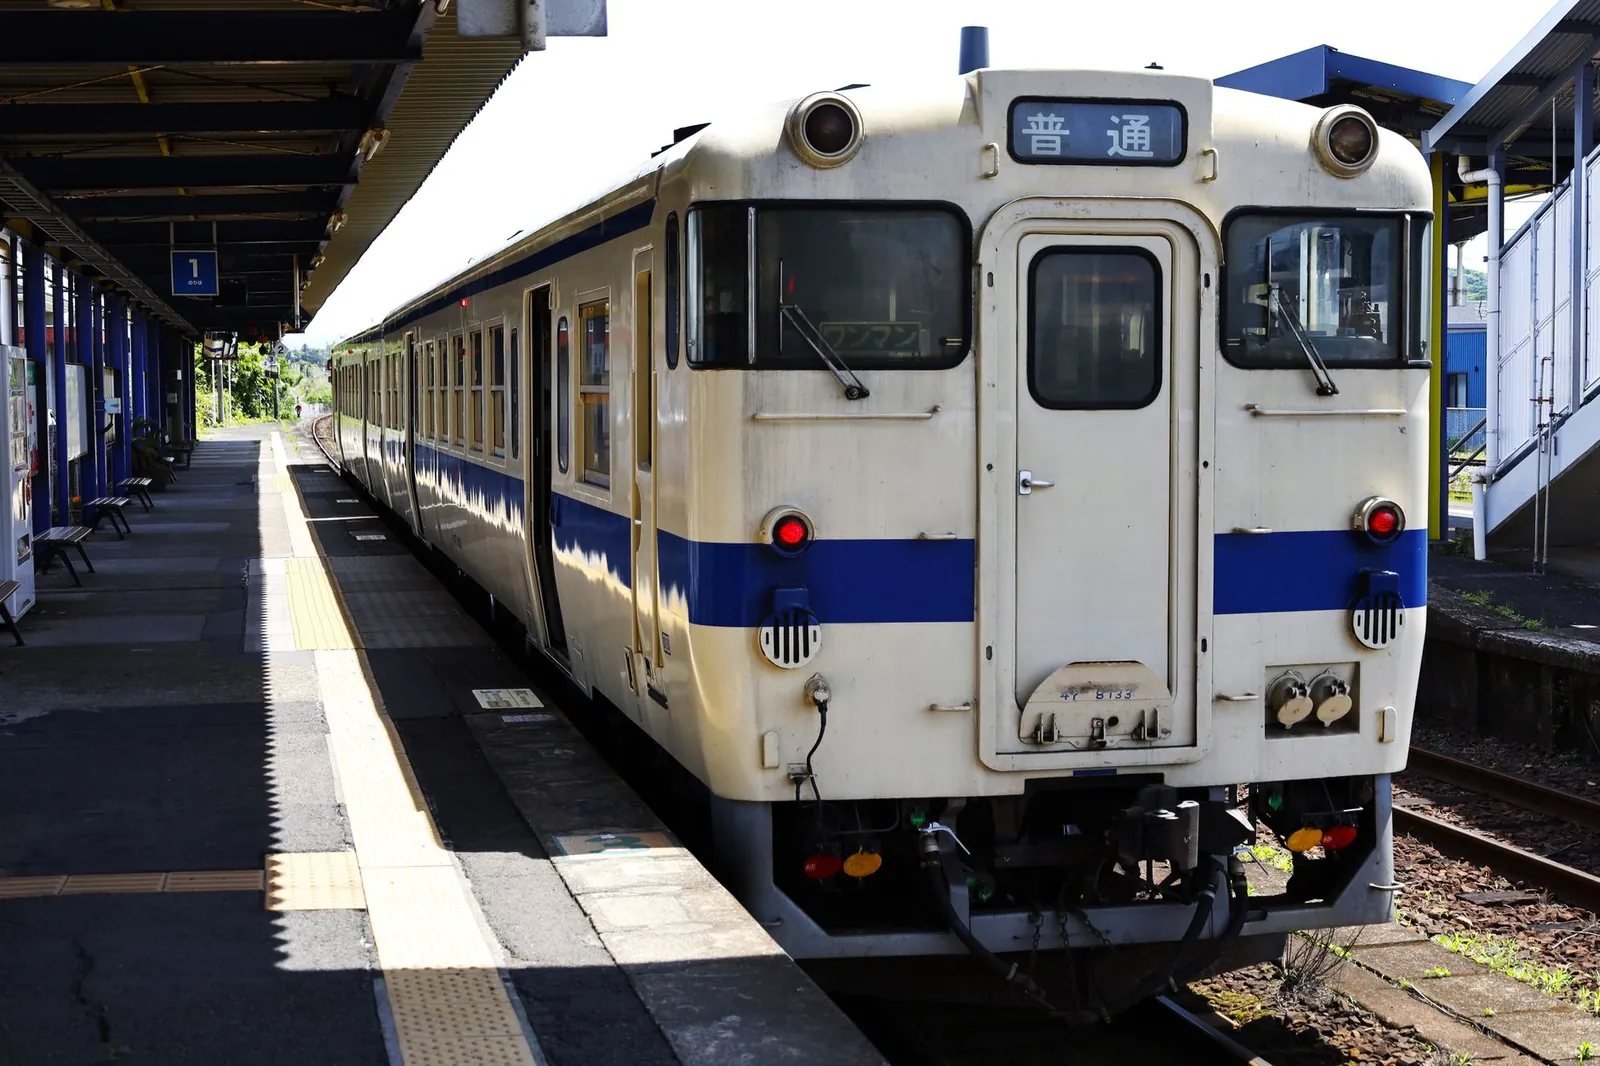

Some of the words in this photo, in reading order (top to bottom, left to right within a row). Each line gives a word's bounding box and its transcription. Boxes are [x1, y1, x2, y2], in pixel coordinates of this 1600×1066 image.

[1022, 112, 1154, 157] 普通
[188, 258, 198, 278] 1
[823, 326, 917, 349] ワンマン
[278, 346, 284, 354] 2
